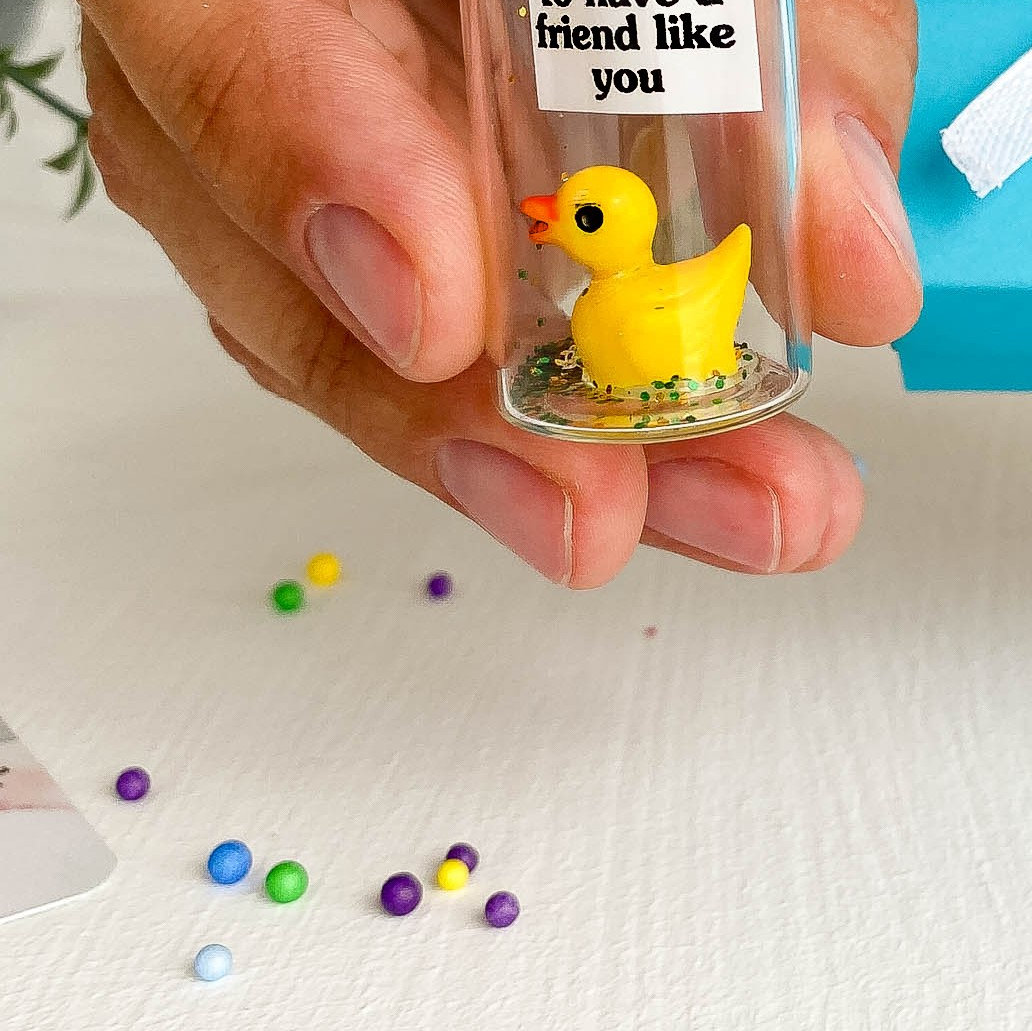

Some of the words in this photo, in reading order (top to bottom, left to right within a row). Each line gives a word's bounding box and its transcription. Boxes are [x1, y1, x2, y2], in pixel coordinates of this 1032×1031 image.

[535, 13, 640, 51] friend
[652, 13, 736, 50] like
[592, 68, 665, 100] you
